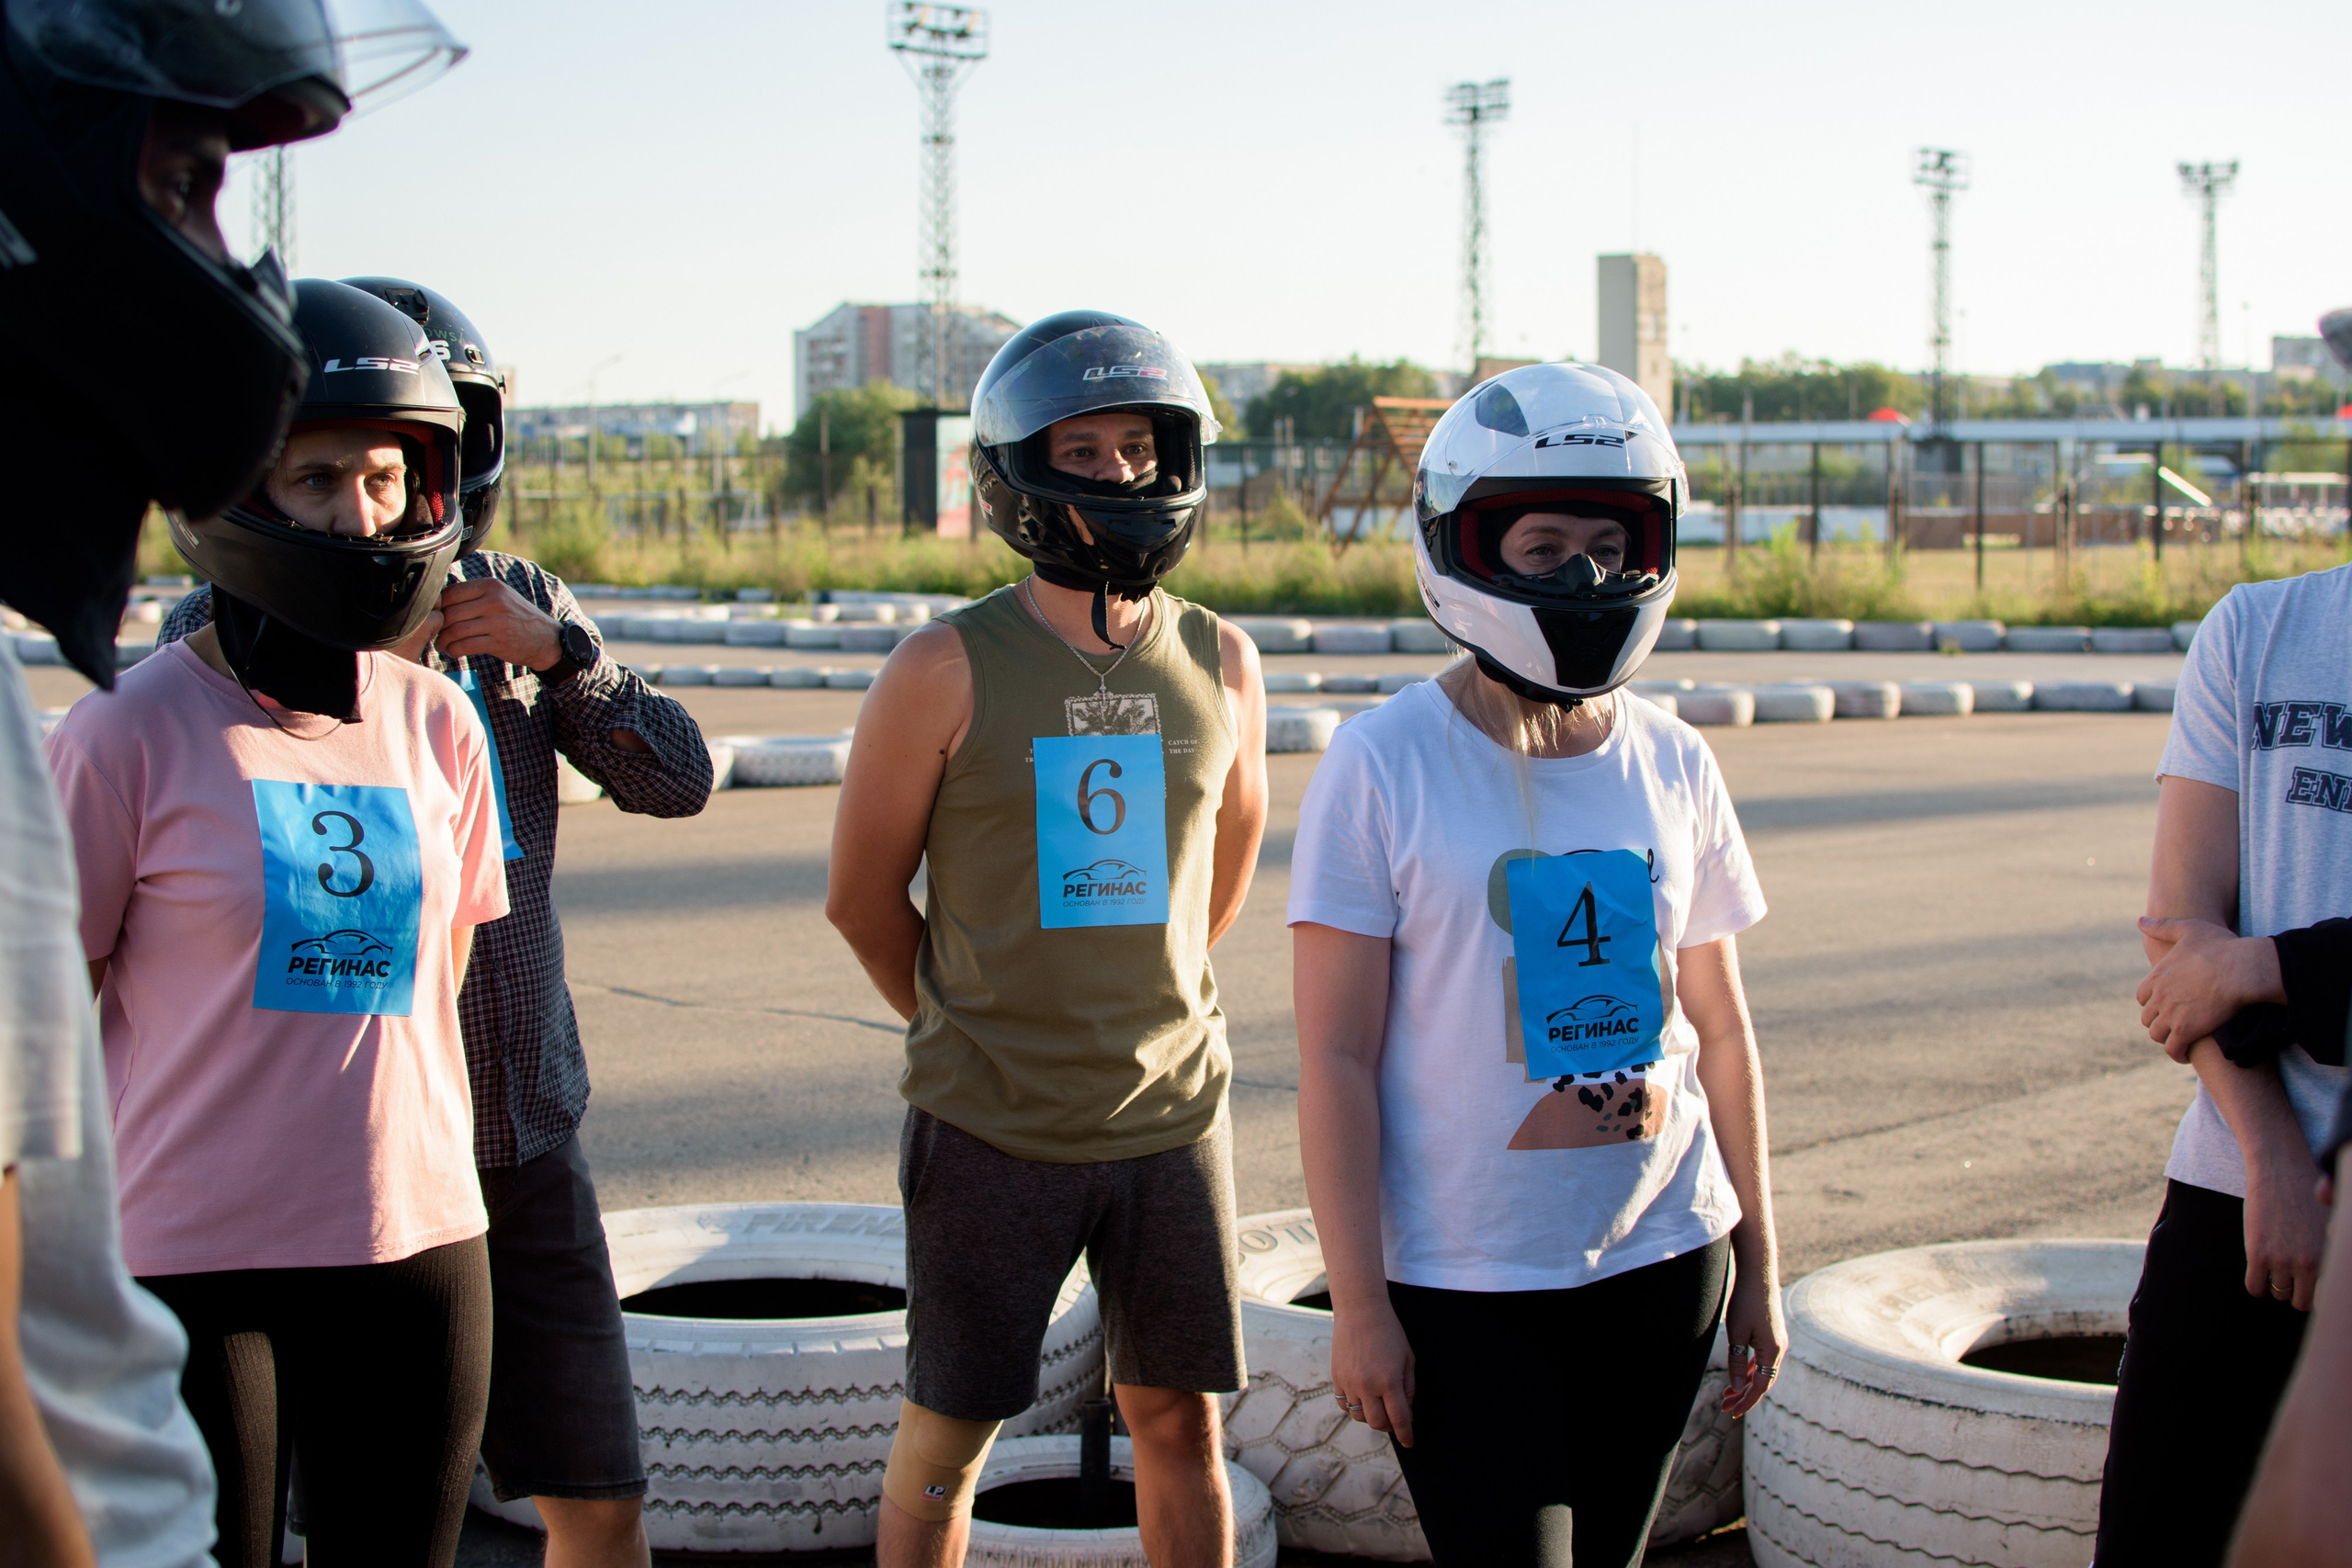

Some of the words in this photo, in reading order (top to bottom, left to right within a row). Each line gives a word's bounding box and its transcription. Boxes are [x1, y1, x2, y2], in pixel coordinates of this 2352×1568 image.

[324, 357, 420, 376] LS2
[1083, 365, 1169, 381] LS2
[1534, 434, 1625, 449] LS2
[1077, 759, 1126, 836] 6
[2285, 766, 2352, 814] EN
[311, 810, 375, 898] 3
[1062, 881, 1148, 898] РЕГИНАС
[1062, 899, 1101, 908] ОСНОВАН
[1556, 880, 1611, 967] 4
[288, 957, 391, 978] РЕГИНАС
[286, 977, 332, 987] ОСНОВАН
[334, 979, 341, 987] В
[364, 981, 388, 989] ГОДУ
[1548, 1017, 1639, 1043] РЕГИНАС
[1550, 1043, 1589, 1054] ОСНОВАН
[1599, 1039, 1616, 1048] 1992
[1618, 1036, 1640, 1046] ГОДУ
[923, 1485, 944, 1496] LP
